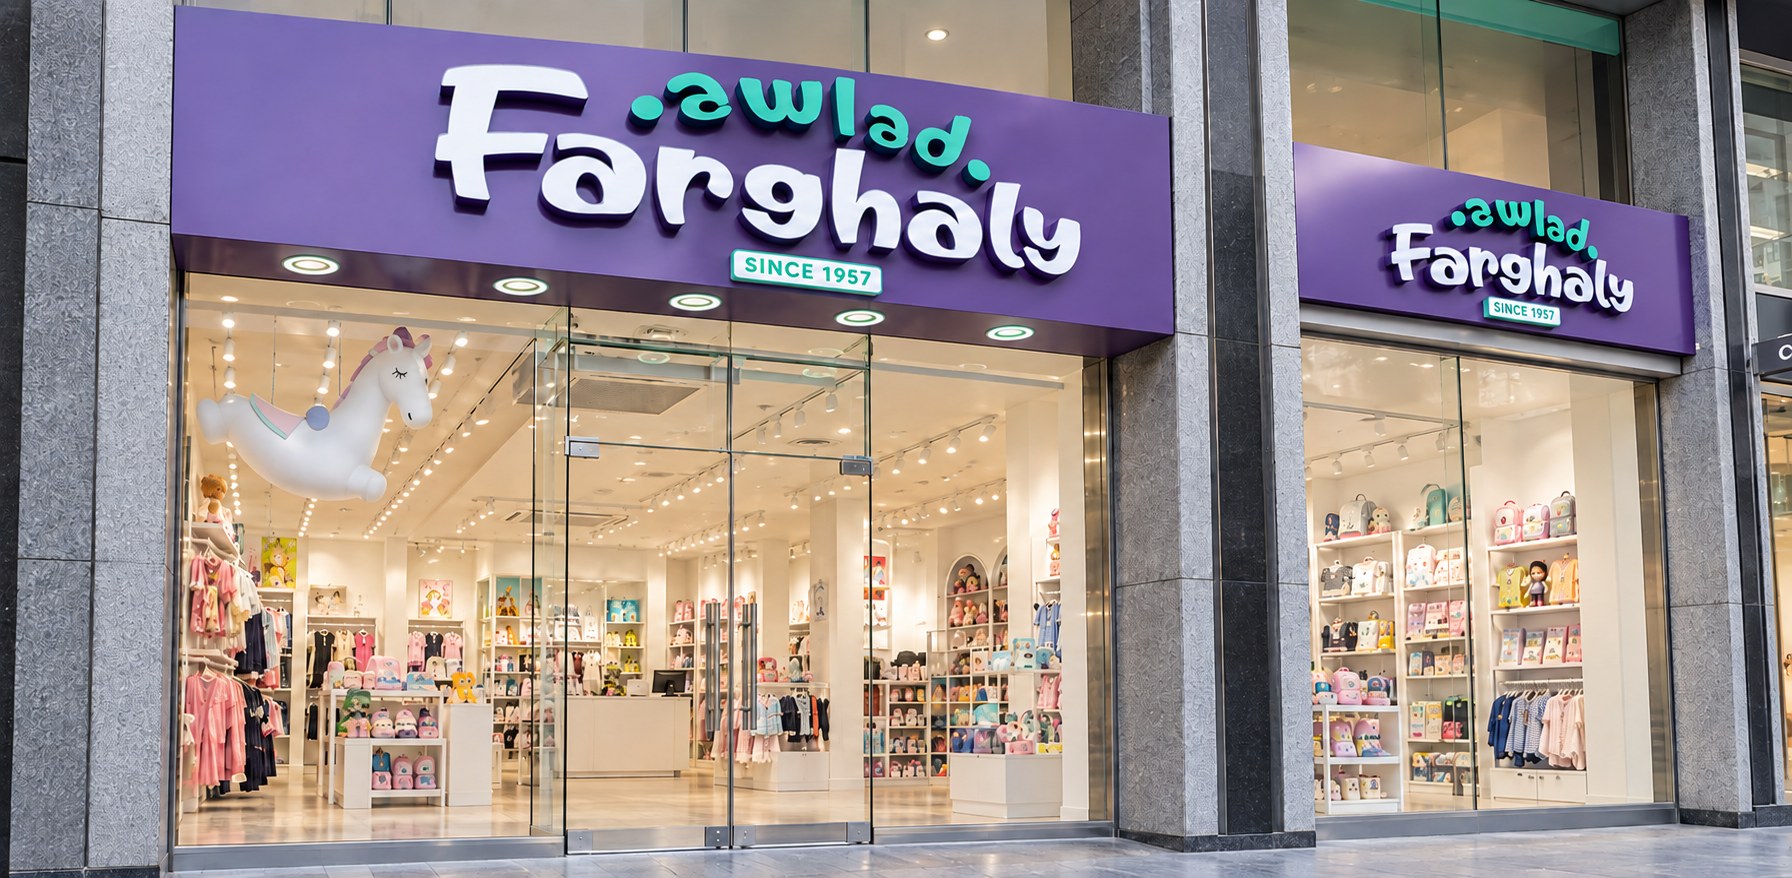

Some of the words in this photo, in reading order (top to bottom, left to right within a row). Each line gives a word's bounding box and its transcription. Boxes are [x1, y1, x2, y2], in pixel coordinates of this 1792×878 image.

[434, 64, 1082, 276] Farghaly
[744, 256, 814, 280] SINCE
[822, 265, 872, 287] 1957
[1391, 222, 1635, 313] Farghaly
[1493, 301, 1528, 317] SINCE
[1530, 307, 1555, 321] 1957
